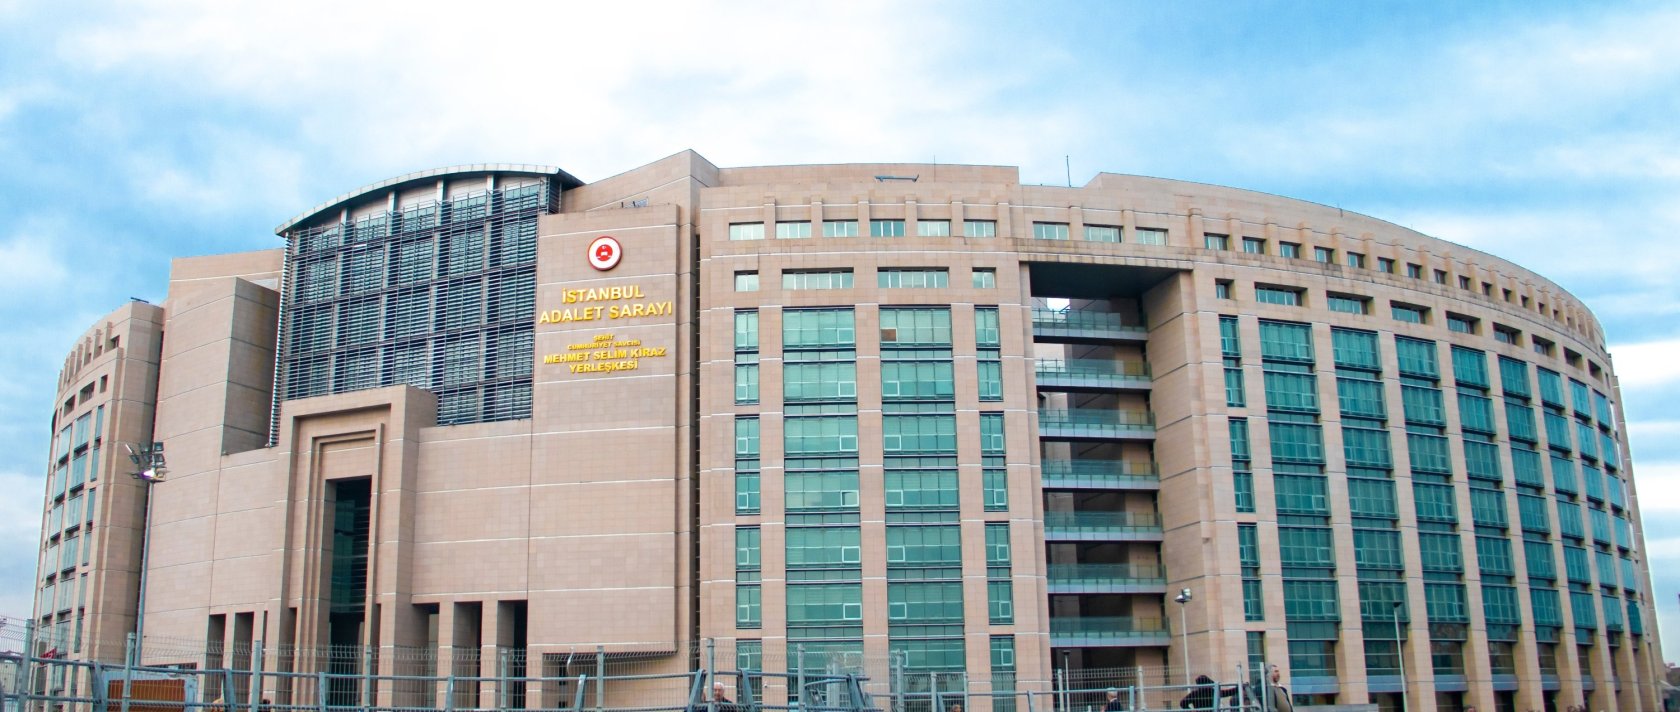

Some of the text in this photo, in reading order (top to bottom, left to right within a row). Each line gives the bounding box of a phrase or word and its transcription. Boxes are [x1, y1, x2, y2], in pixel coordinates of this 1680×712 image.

[562, 285, 645, 303] İSTANBUL
[539, 301, 673, 323] ADALET SARAYI
[544, 346, 666, 364] MEHMET SELİM KİRAZ
[569, 360, 638, 373] YERLEŞKESİ
